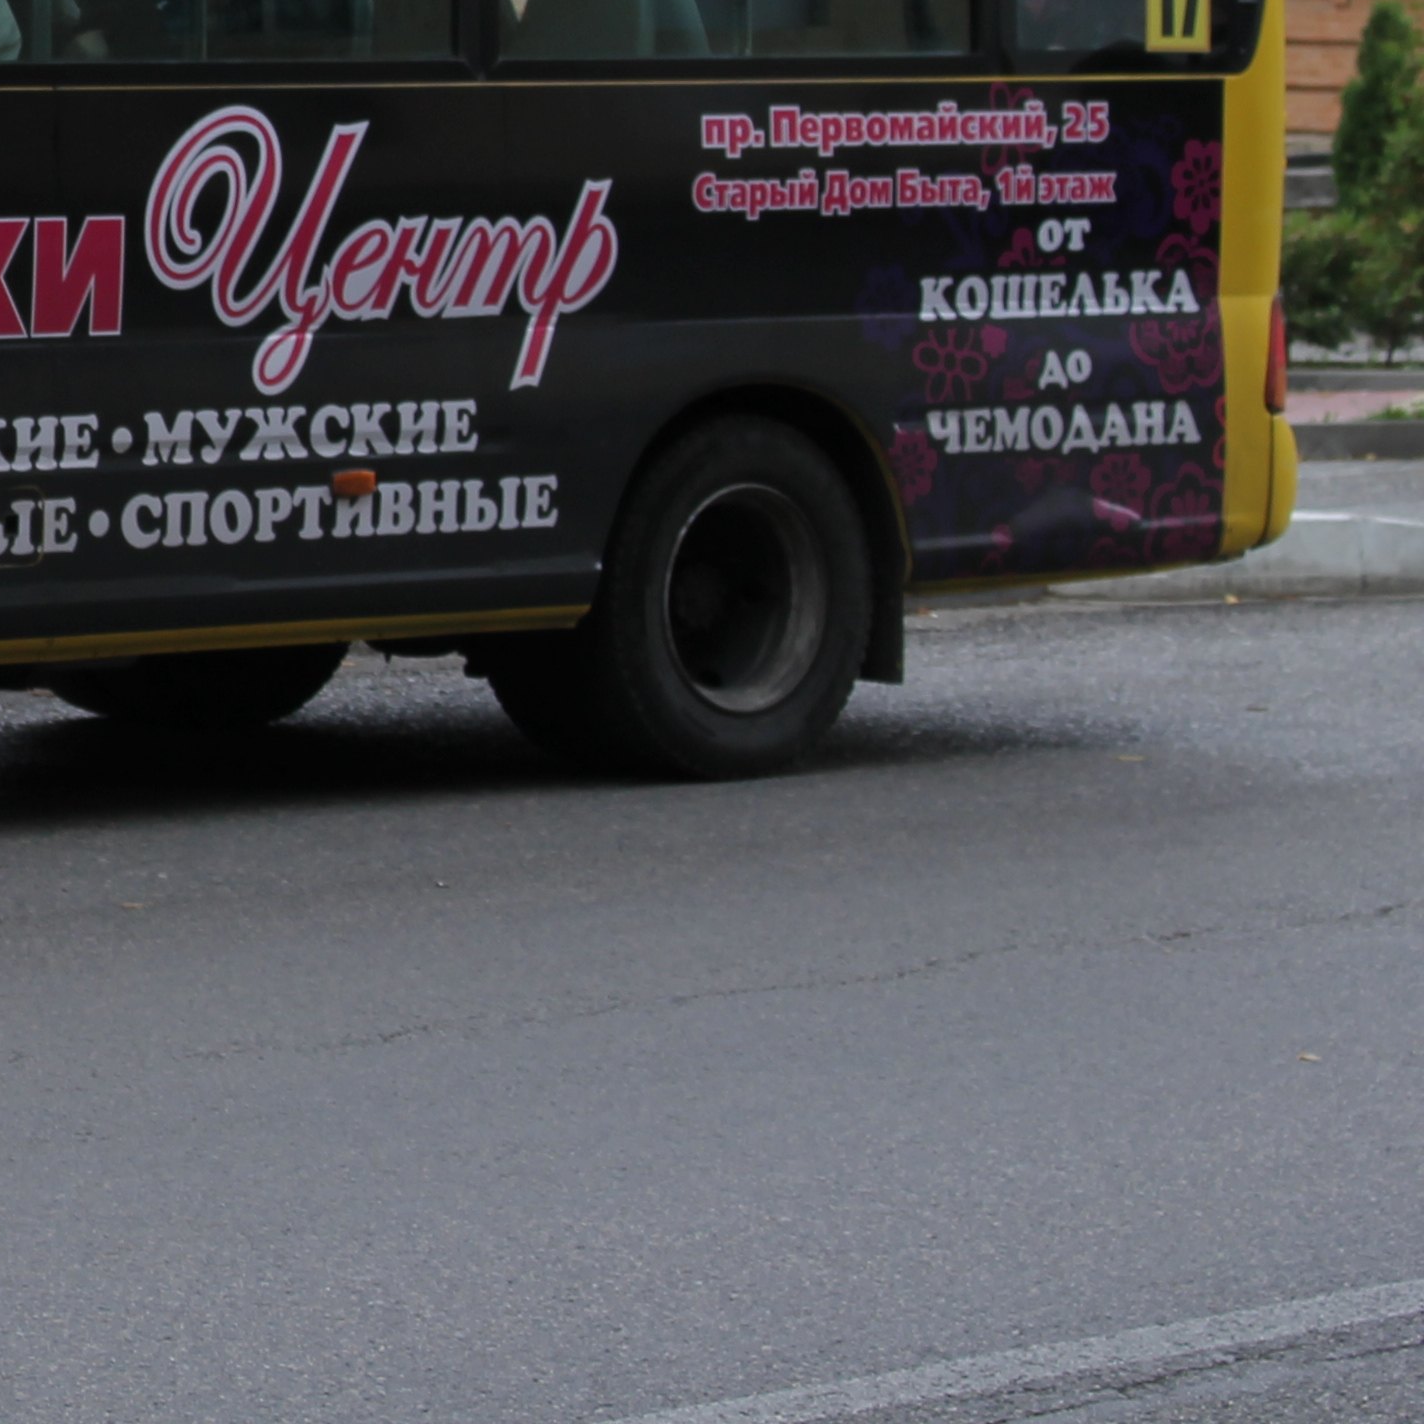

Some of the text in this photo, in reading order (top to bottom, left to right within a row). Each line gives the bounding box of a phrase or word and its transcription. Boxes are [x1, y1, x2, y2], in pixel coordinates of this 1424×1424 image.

[701, 101, 1110, 158] пр. Первомайский, 25
[693, 164, 1118, 221] Старый Дом Быта, 1й этаж
[144, 104, 619, 396] Центр
[918, 268, 1200, 322] КОШЕЛЬКА
[926, 399, 1202, 454] ЧЕМОДАНА
